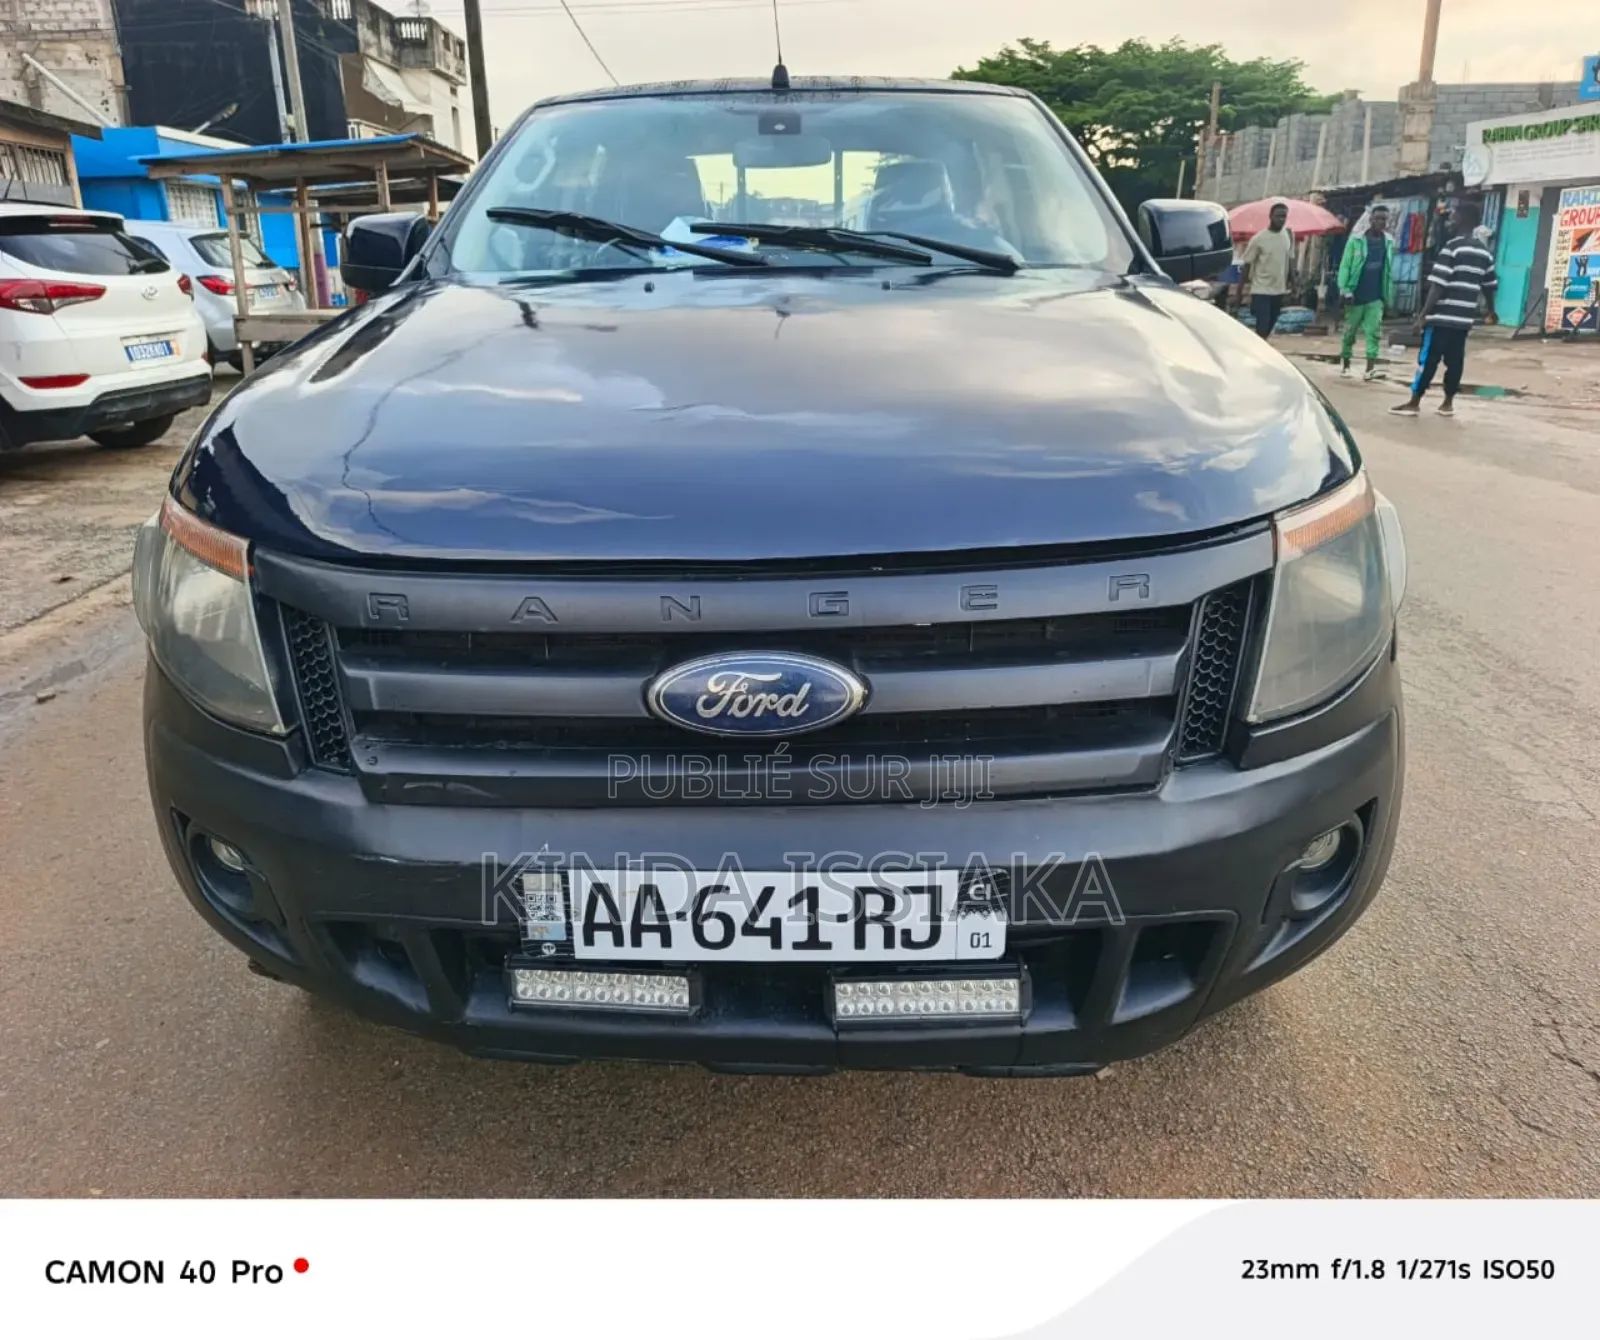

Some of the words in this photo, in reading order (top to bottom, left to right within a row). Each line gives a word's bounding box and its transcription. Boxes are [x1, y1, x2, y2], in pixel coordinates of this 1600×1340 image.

[367, 573, 1152, 625] RANGER
[695, 671, 811, 718] Ford
[969, 932, 992, 949] 01
